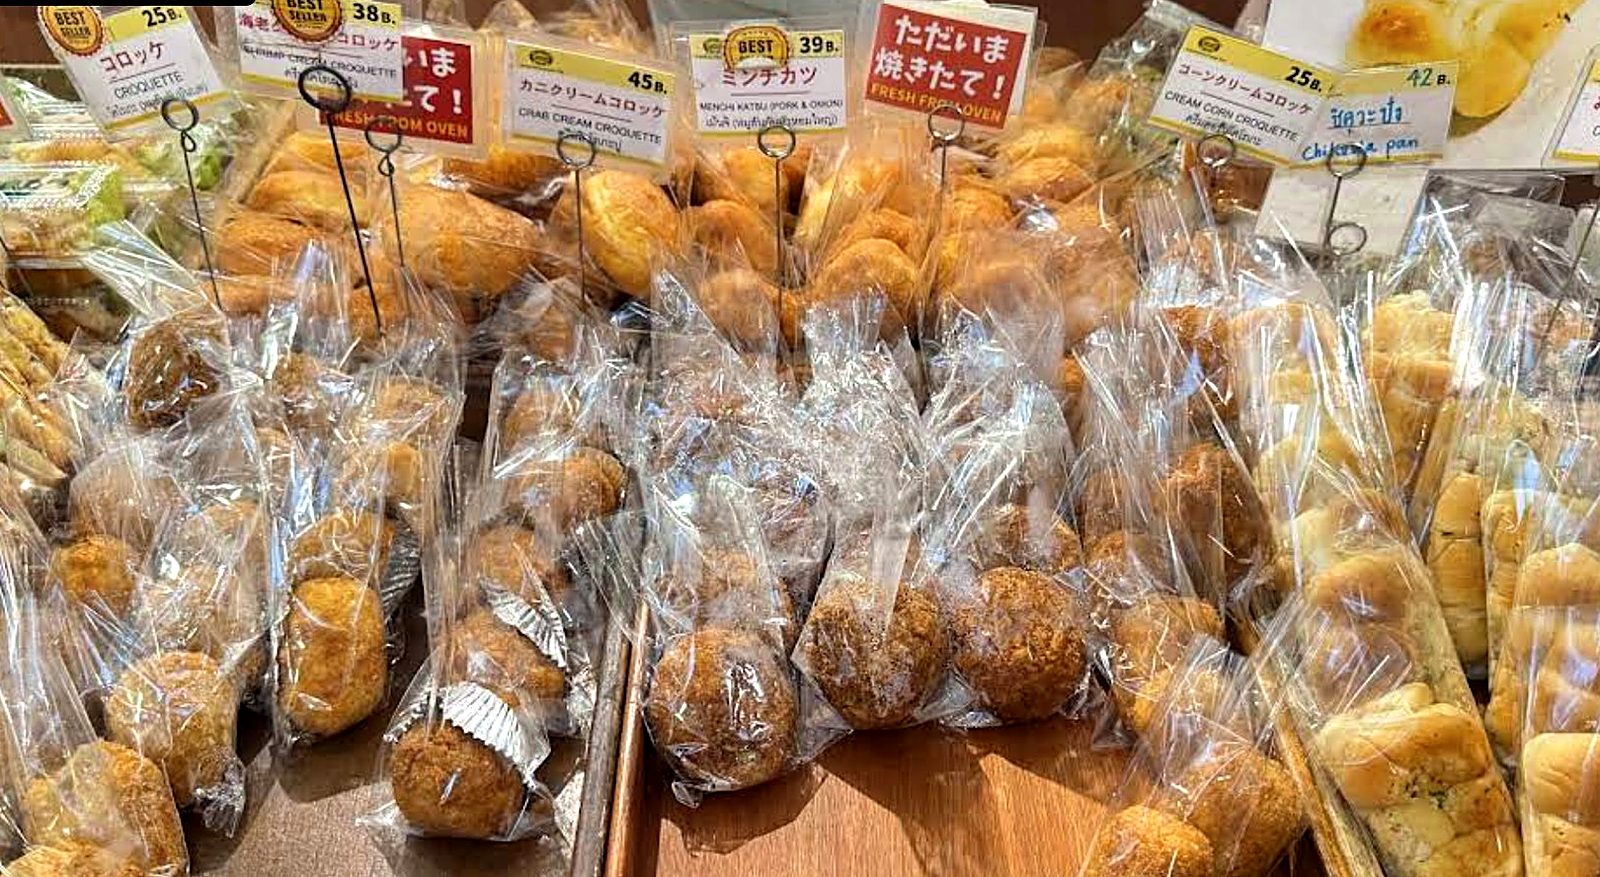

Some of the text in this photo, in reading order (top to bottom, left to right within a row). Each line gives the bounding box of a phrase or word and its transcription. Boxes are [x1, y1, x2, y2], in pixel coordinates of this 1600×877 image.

[286, 0, 324, 10] BEST
[54, 11, 86, 25] BEST
[739, 40, 773, 53] BEST
[895, 15, 1010, 63] ただいま
[100, 41, 165, 73] コロッケ
[330, 61, 397, 78] CROQUETTE
[114, 71, 184, 99] CROQUETTE
[722, 66, 818, 87] ミンチカツ
[519, 79, 665, 119] カニクリームコロッケ
[1178, 64, 1314, 115] コーンクリームコロッケ
[700, 102, 735, 112] MENCHI
[737, 102, 767, 111] KATSU
[871, 83, 917, 105] FRESH
[963, 104, 1001, 122] OVEN
[519, 107, 550, 122] CRAB
[552, 112, 593, 130] CREAM
[595, 122, 662, 145] CROQUETTE
[1164, 91, 1202, 108] CREAM
[1203, 102, 1235, 119] CORN
[1235, 113, 1300, 142] CROQUETTE
[427, 122, 468, 137] OVEN
[1386, 137, 1419, 159] pan
